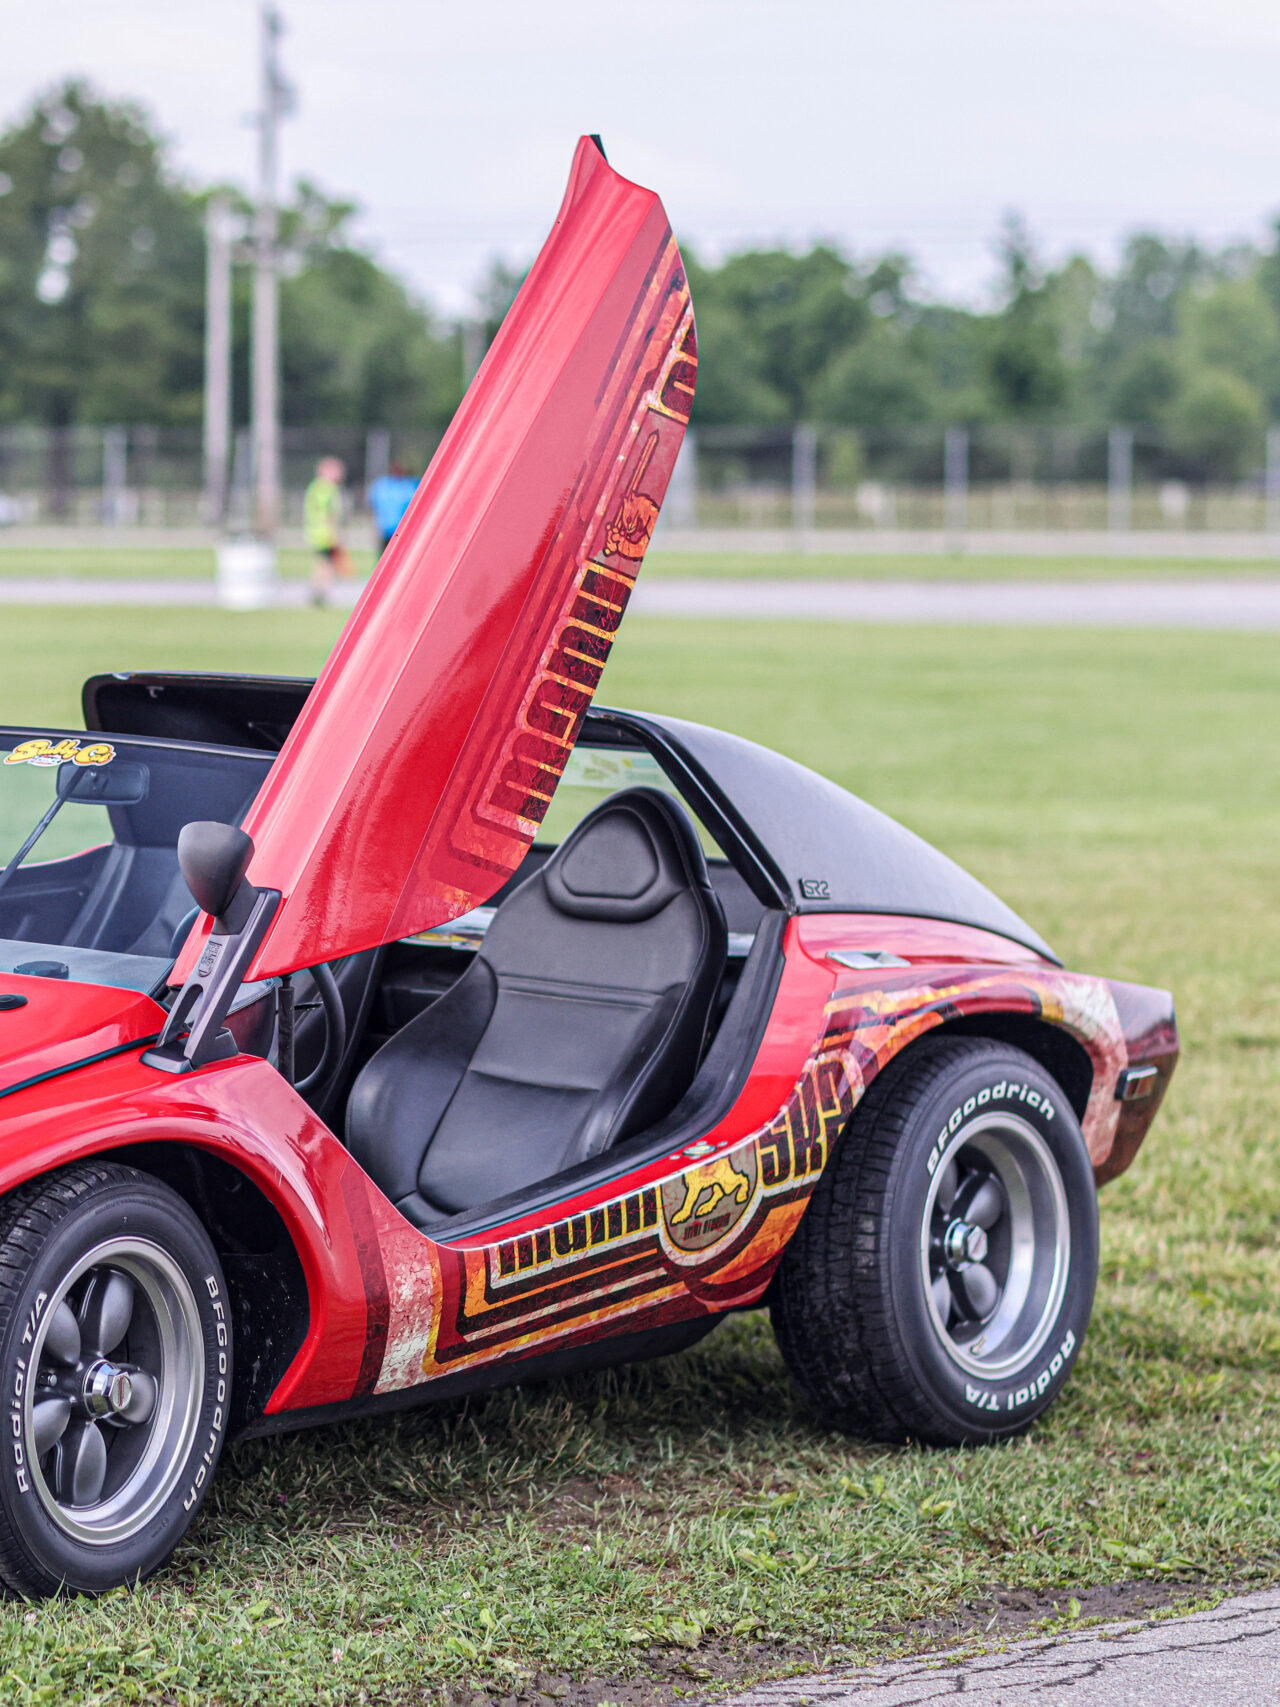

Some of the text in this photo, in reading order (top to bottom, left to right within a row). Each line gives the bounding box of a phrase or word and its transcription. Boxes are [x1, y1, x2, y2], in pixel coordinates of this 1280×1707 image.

[804, 879, 830, 896] SR2
[926, 1080, 1056, 1176] BFGoodrich
[11, 1291, 48, 1494] Radial T/A
[183, 1275, 228, 1512] BFGoodrich
[965, 1329, 1077, 1411] Radial T/A
